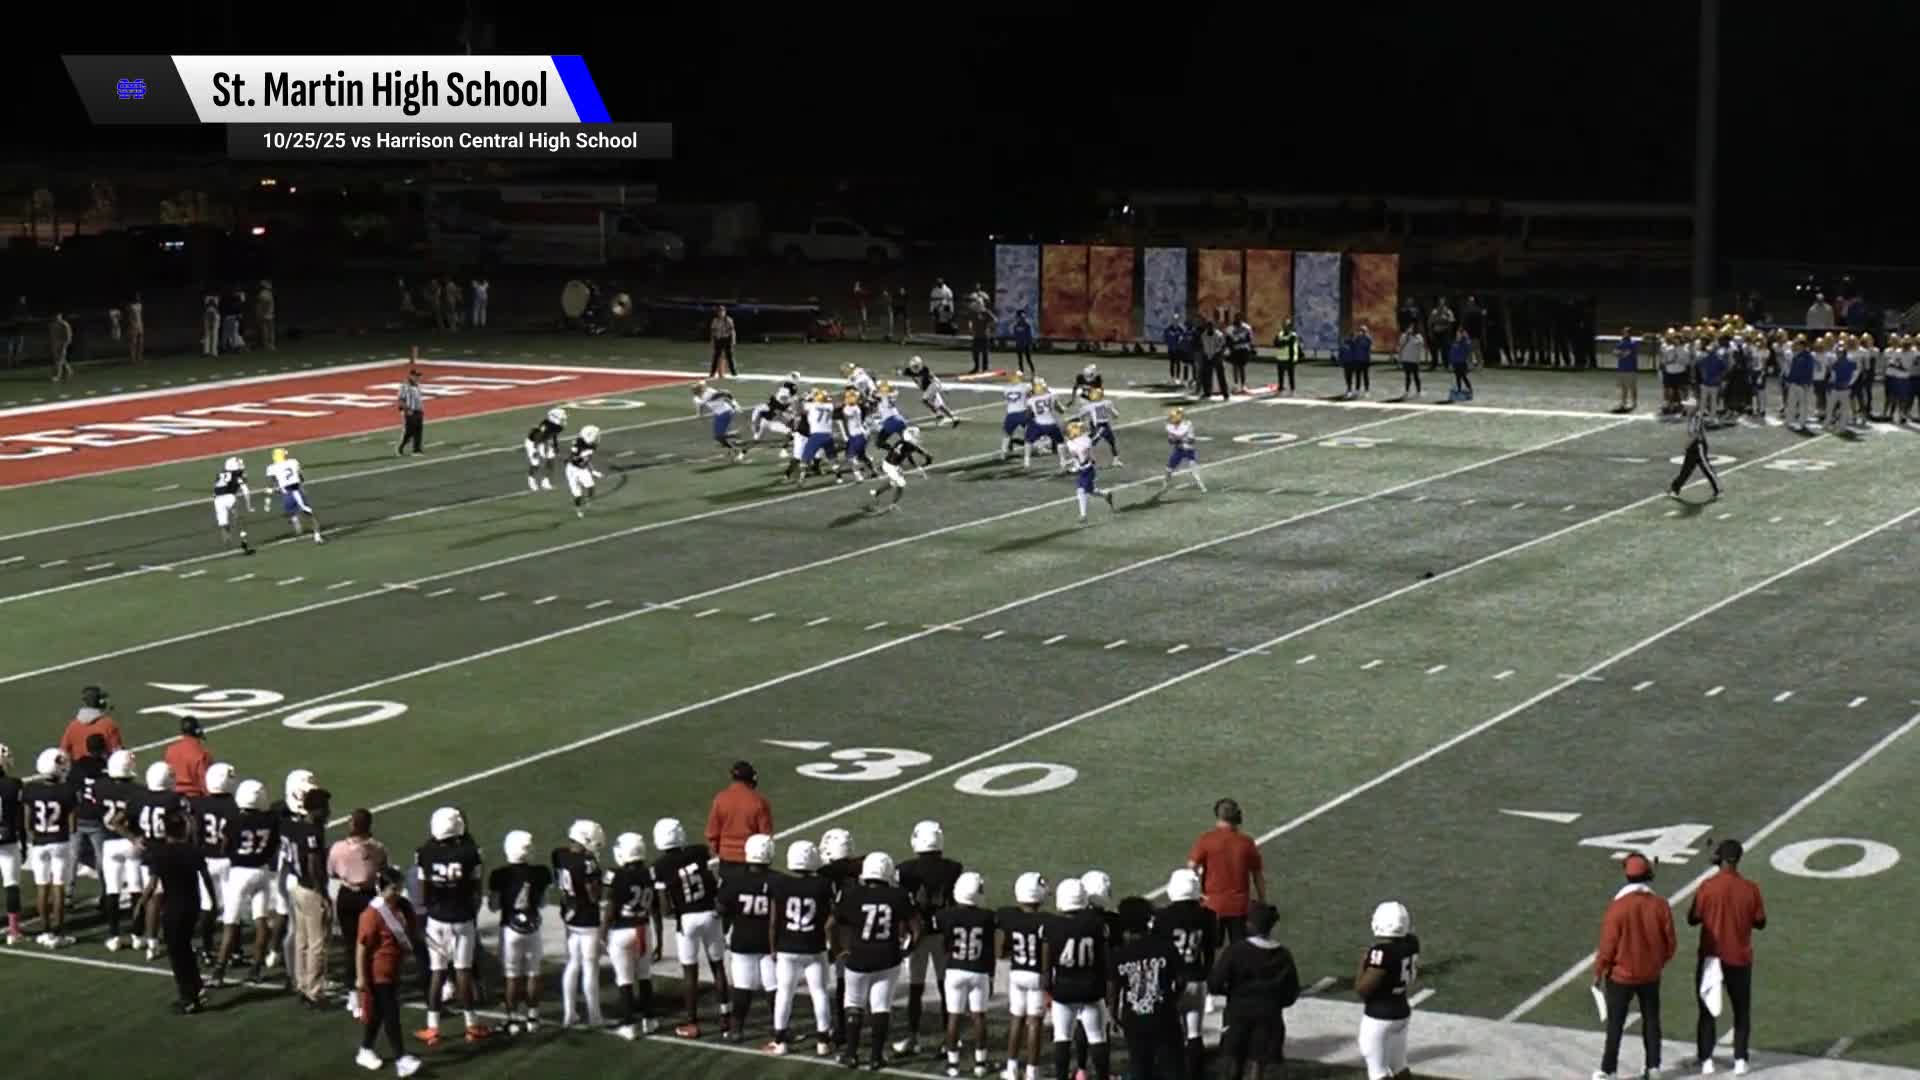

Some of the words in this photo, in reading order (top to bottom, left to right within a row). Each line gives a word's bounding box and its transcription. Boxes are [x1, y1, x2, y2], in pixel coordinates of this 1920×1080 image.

[33, 799, 61, 833] 32
[138, 805, 166, 839] 46
[237, 828, 271, 855] 37
[785, 896, 817, 932] 92
[861, 903, 893, 941] 73
[952, 926, 984, 960] 36
